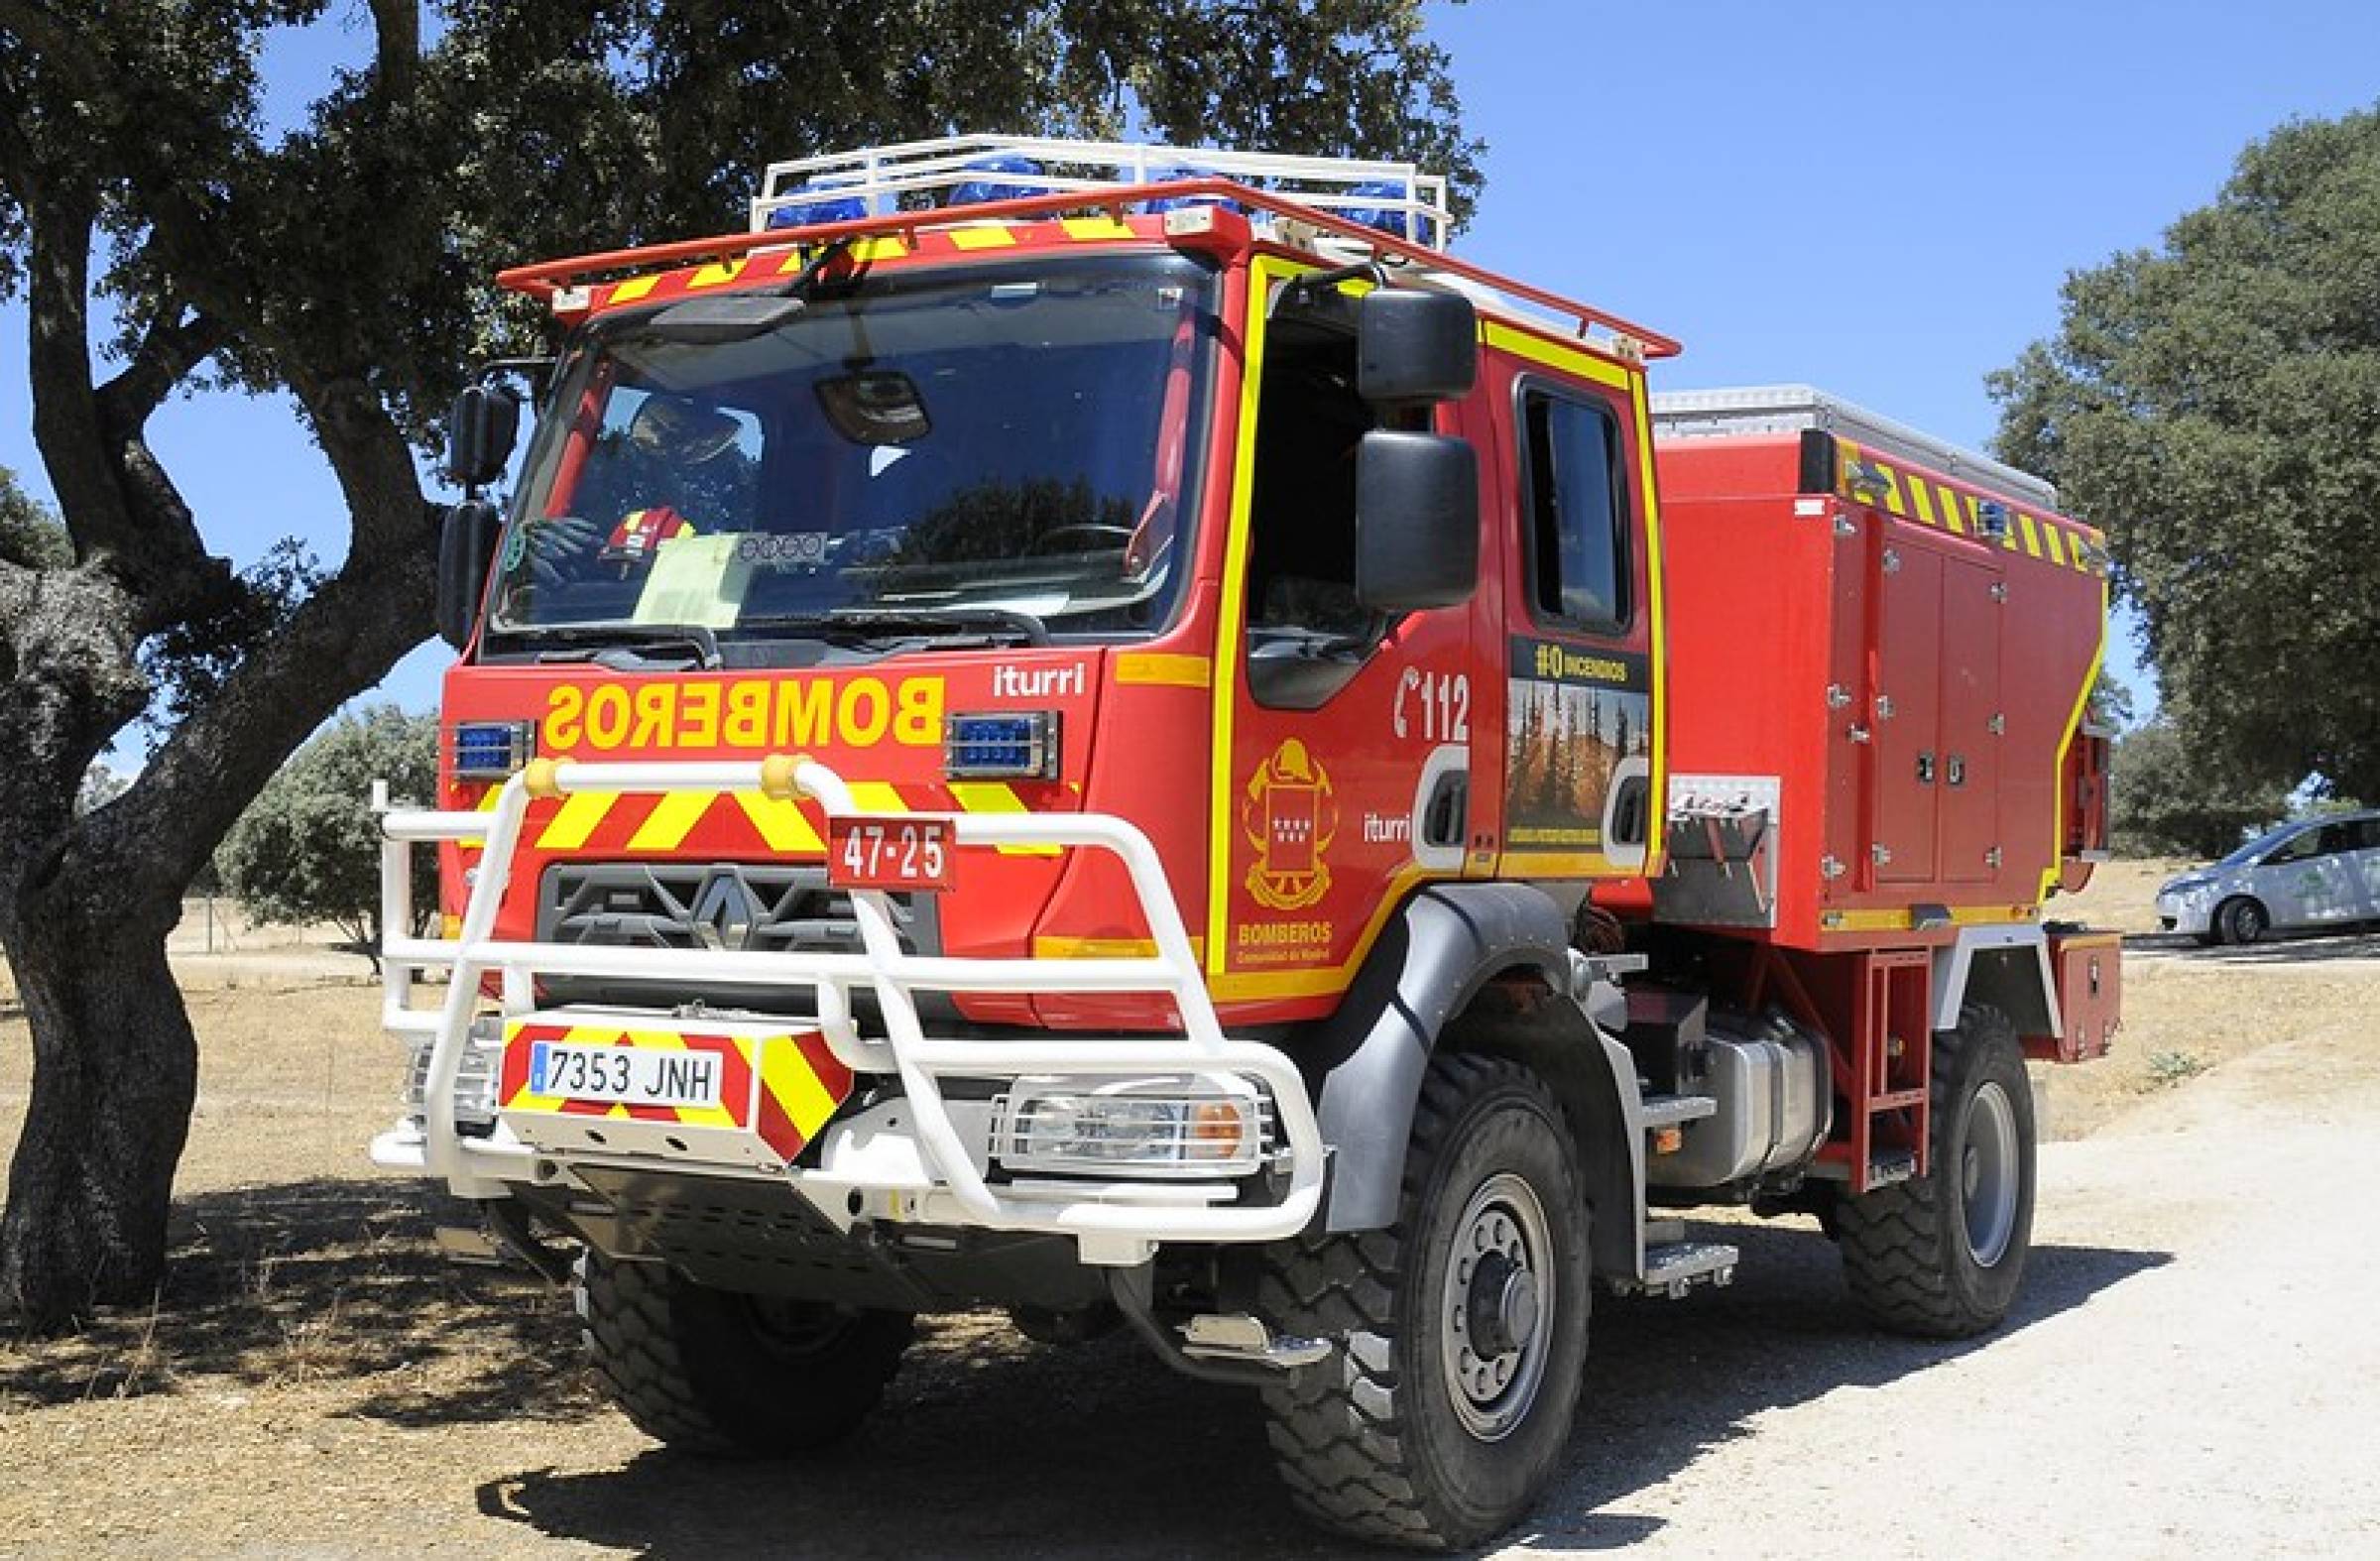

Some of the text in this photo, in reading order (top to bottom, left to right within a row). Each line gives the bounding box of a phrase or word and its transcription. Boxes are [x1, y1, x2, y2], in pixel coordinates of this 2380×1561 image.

[994, 662, 1084, 696] iturri
[1421, 671, 1470, 741] 112
[1364, 812, 1411, 842] iturri
[1238, 921, 1332, 946] BOMBEROS
[549, 1049, 711, 1100] 7353 JNH
